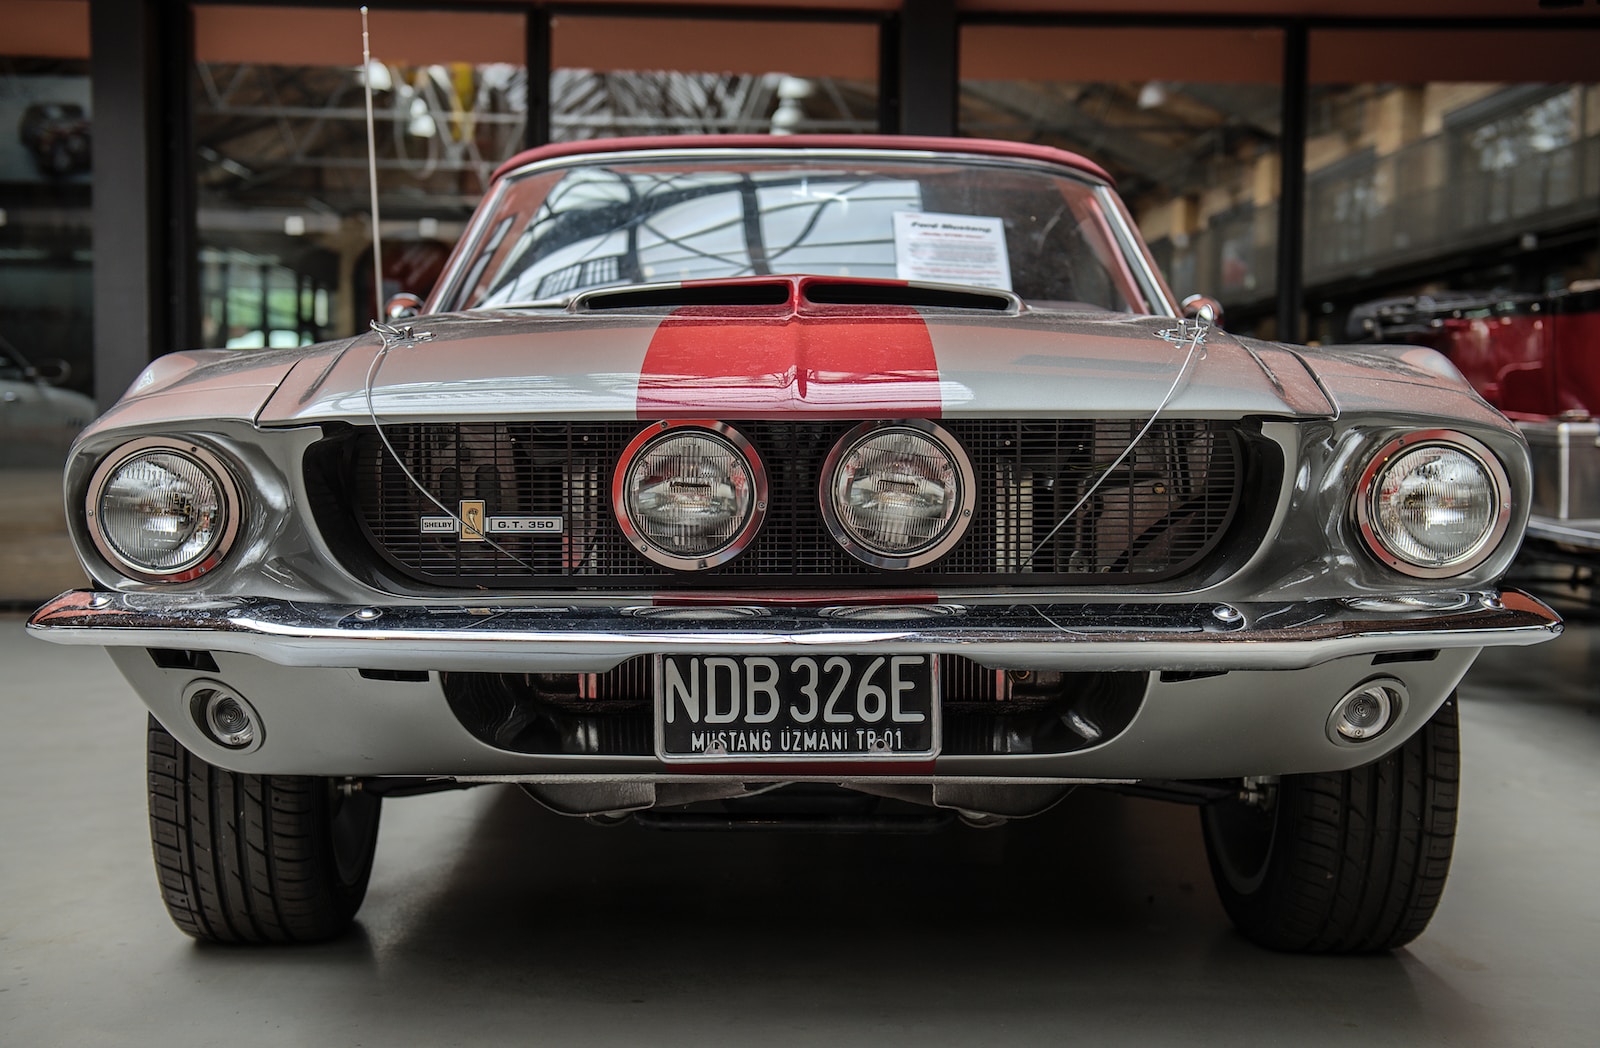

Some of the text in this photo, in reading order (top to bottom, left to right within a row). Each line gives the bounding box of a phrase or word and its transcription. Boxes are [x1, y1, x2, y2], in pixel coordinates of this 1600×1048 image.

[424, 521, 452, 529] SHELBY
[498, 521, 554, 529] G.T. 350
[665, 656, 926, 724] NDB 326E
[691, 730, 772, 752] MUSTANG
